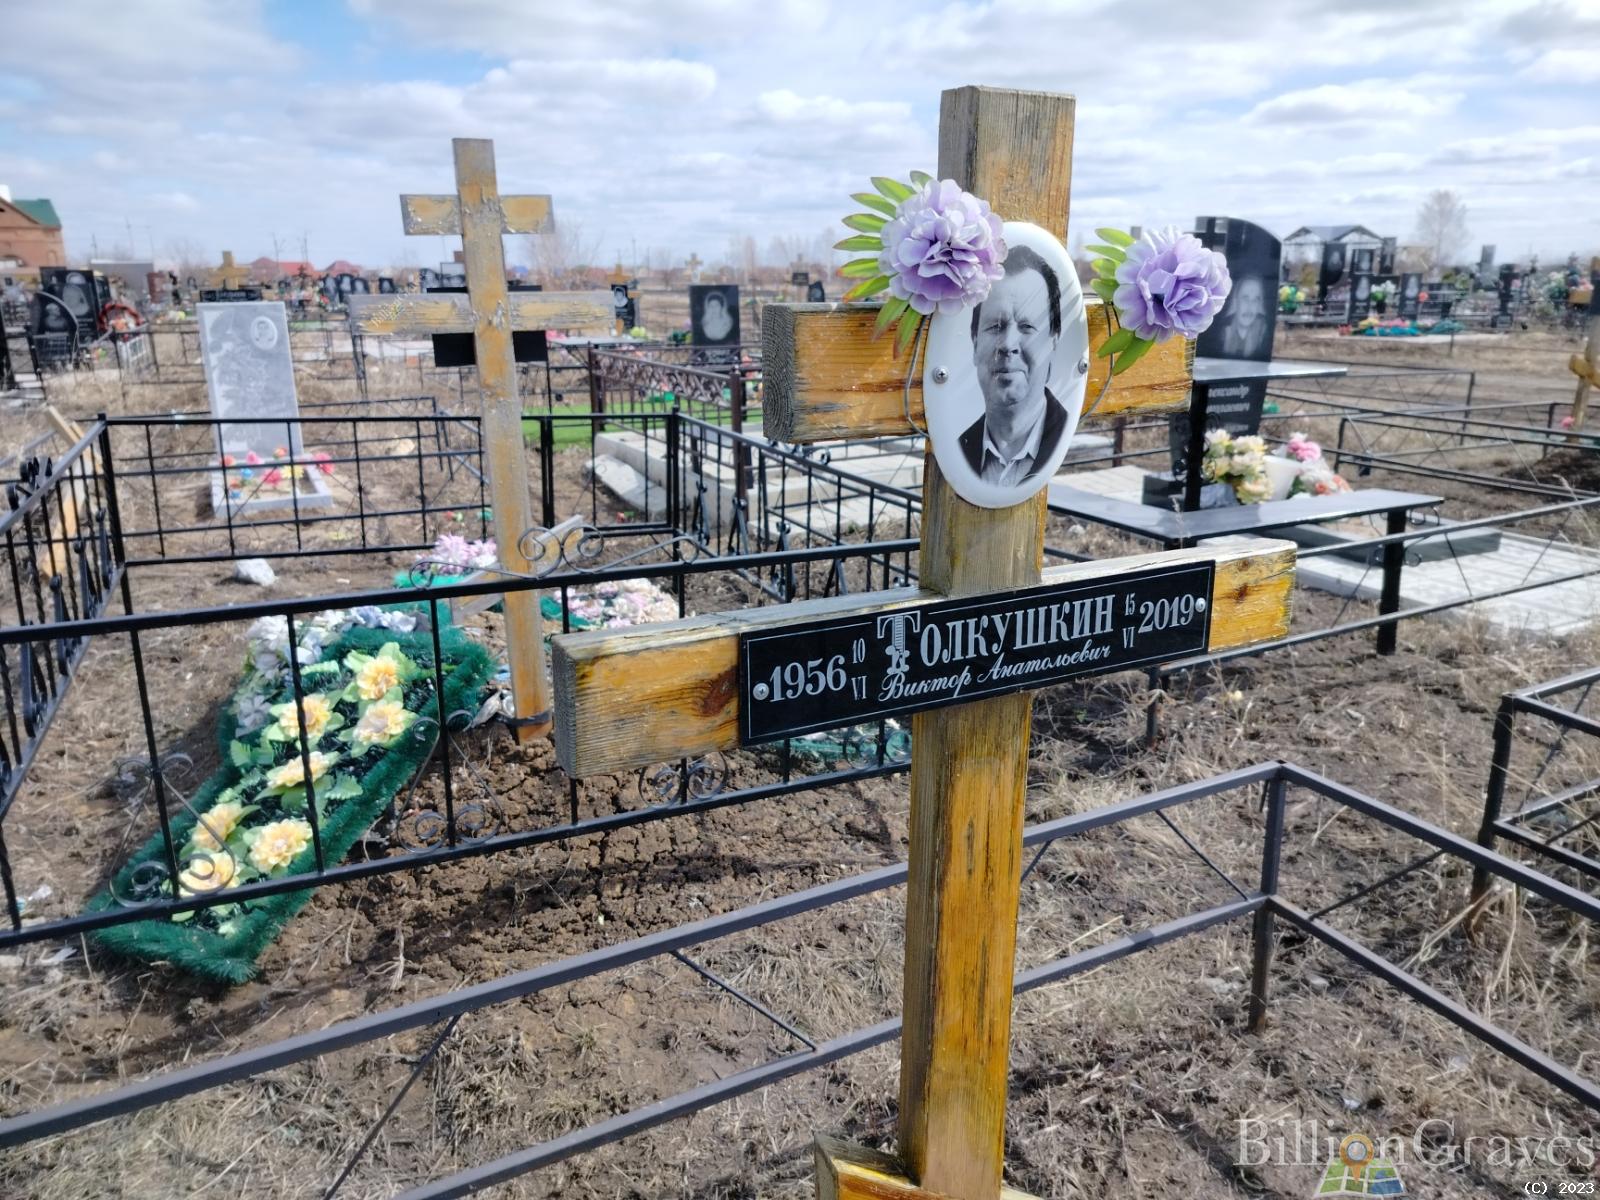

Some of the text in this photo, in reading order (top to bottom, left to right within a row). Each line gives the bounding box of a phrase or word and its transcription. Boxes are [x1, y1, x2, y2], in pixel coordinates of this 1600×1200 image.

[1125, 593, 1136, 616] 15
[1138, 594, 1195, 634] 2019
[1123, 626, 1136, 649] VI
[852, 638, 866, 664] 10
[769, 654, 847, 702] 1956
[879, 639, 1111, 701] Виктор Анатольевич
[851, 675, 867, 700] VI
